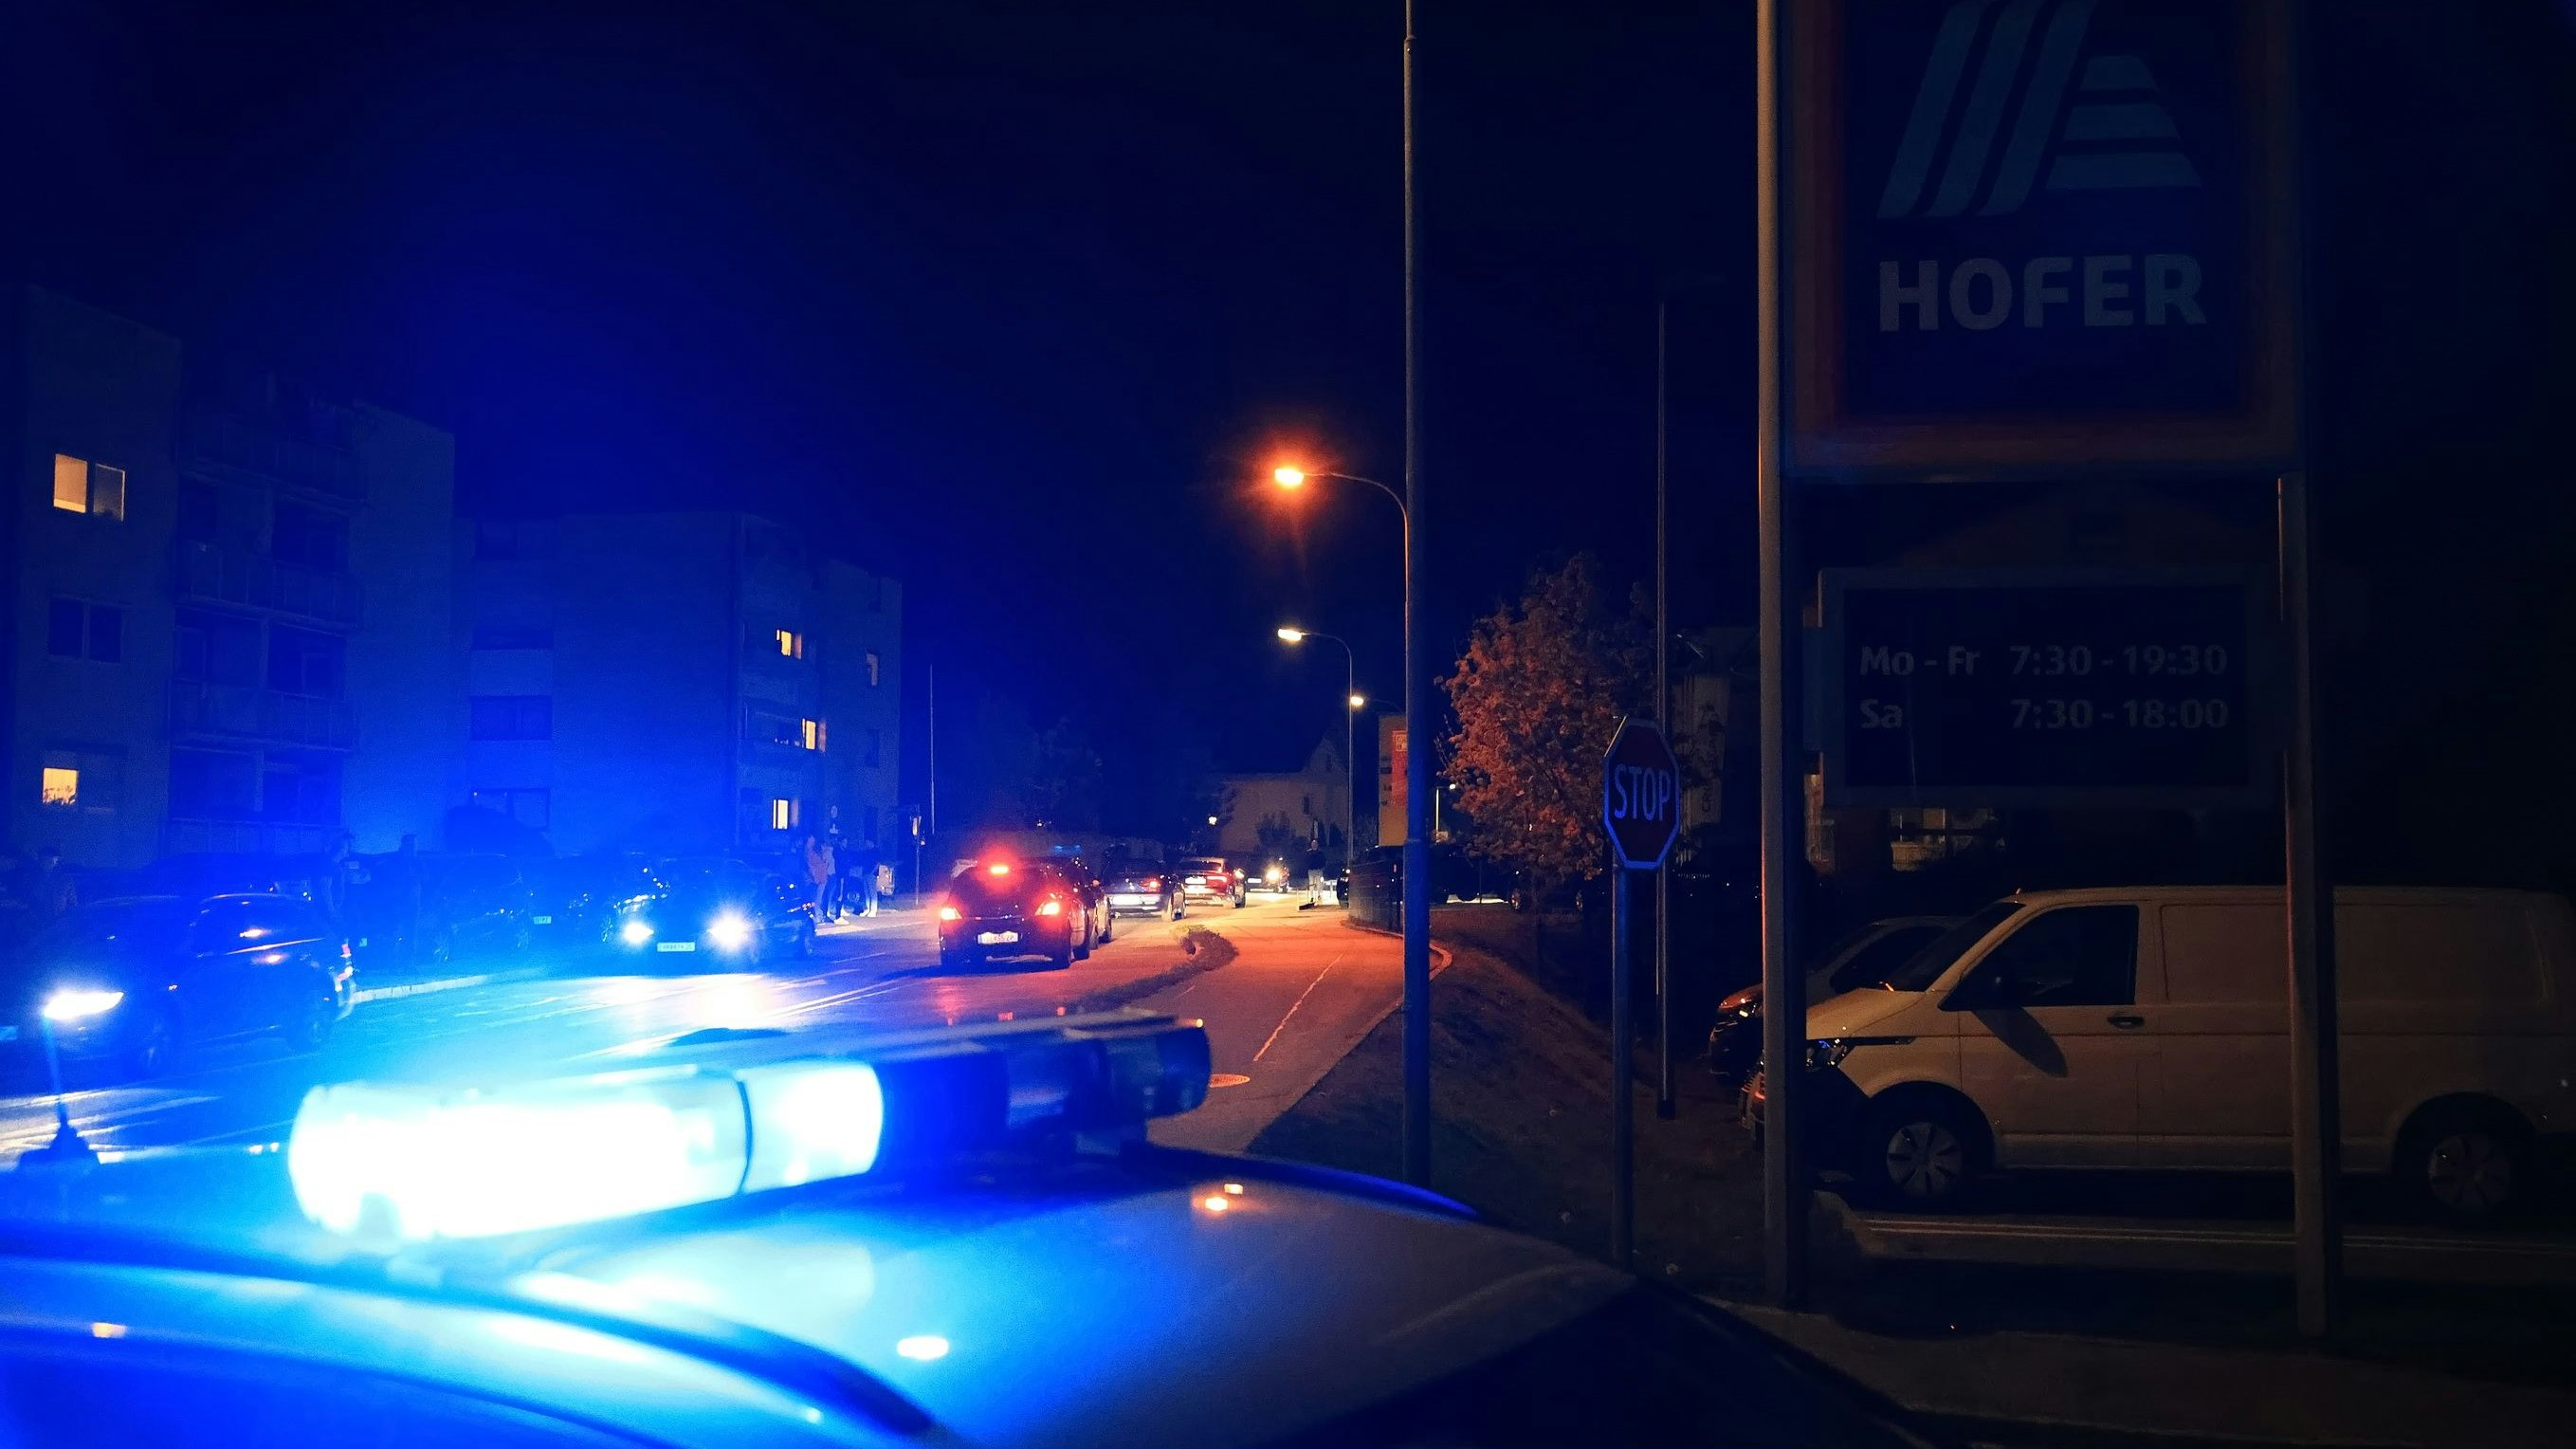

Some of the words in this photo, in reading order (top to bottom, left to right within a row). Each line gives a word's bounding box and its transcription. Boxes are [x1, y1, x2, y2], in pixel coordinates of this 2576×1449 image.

[1878, 253, 2207, 332] HOFER
[1859, 645, 1914, 676] Mo
[1946, 645, 1982, 676] Fr
[2009, 645, 2092, 676] 7:30
[2123, 645, 2227, 676] 19:30
[1859, 699, 1903, 729] Sa
[2010, 699, 2093, 729] 7:30
[2123, 698, 2230, 729] 18:00
[1614, 763, 1672, 821] STOP
